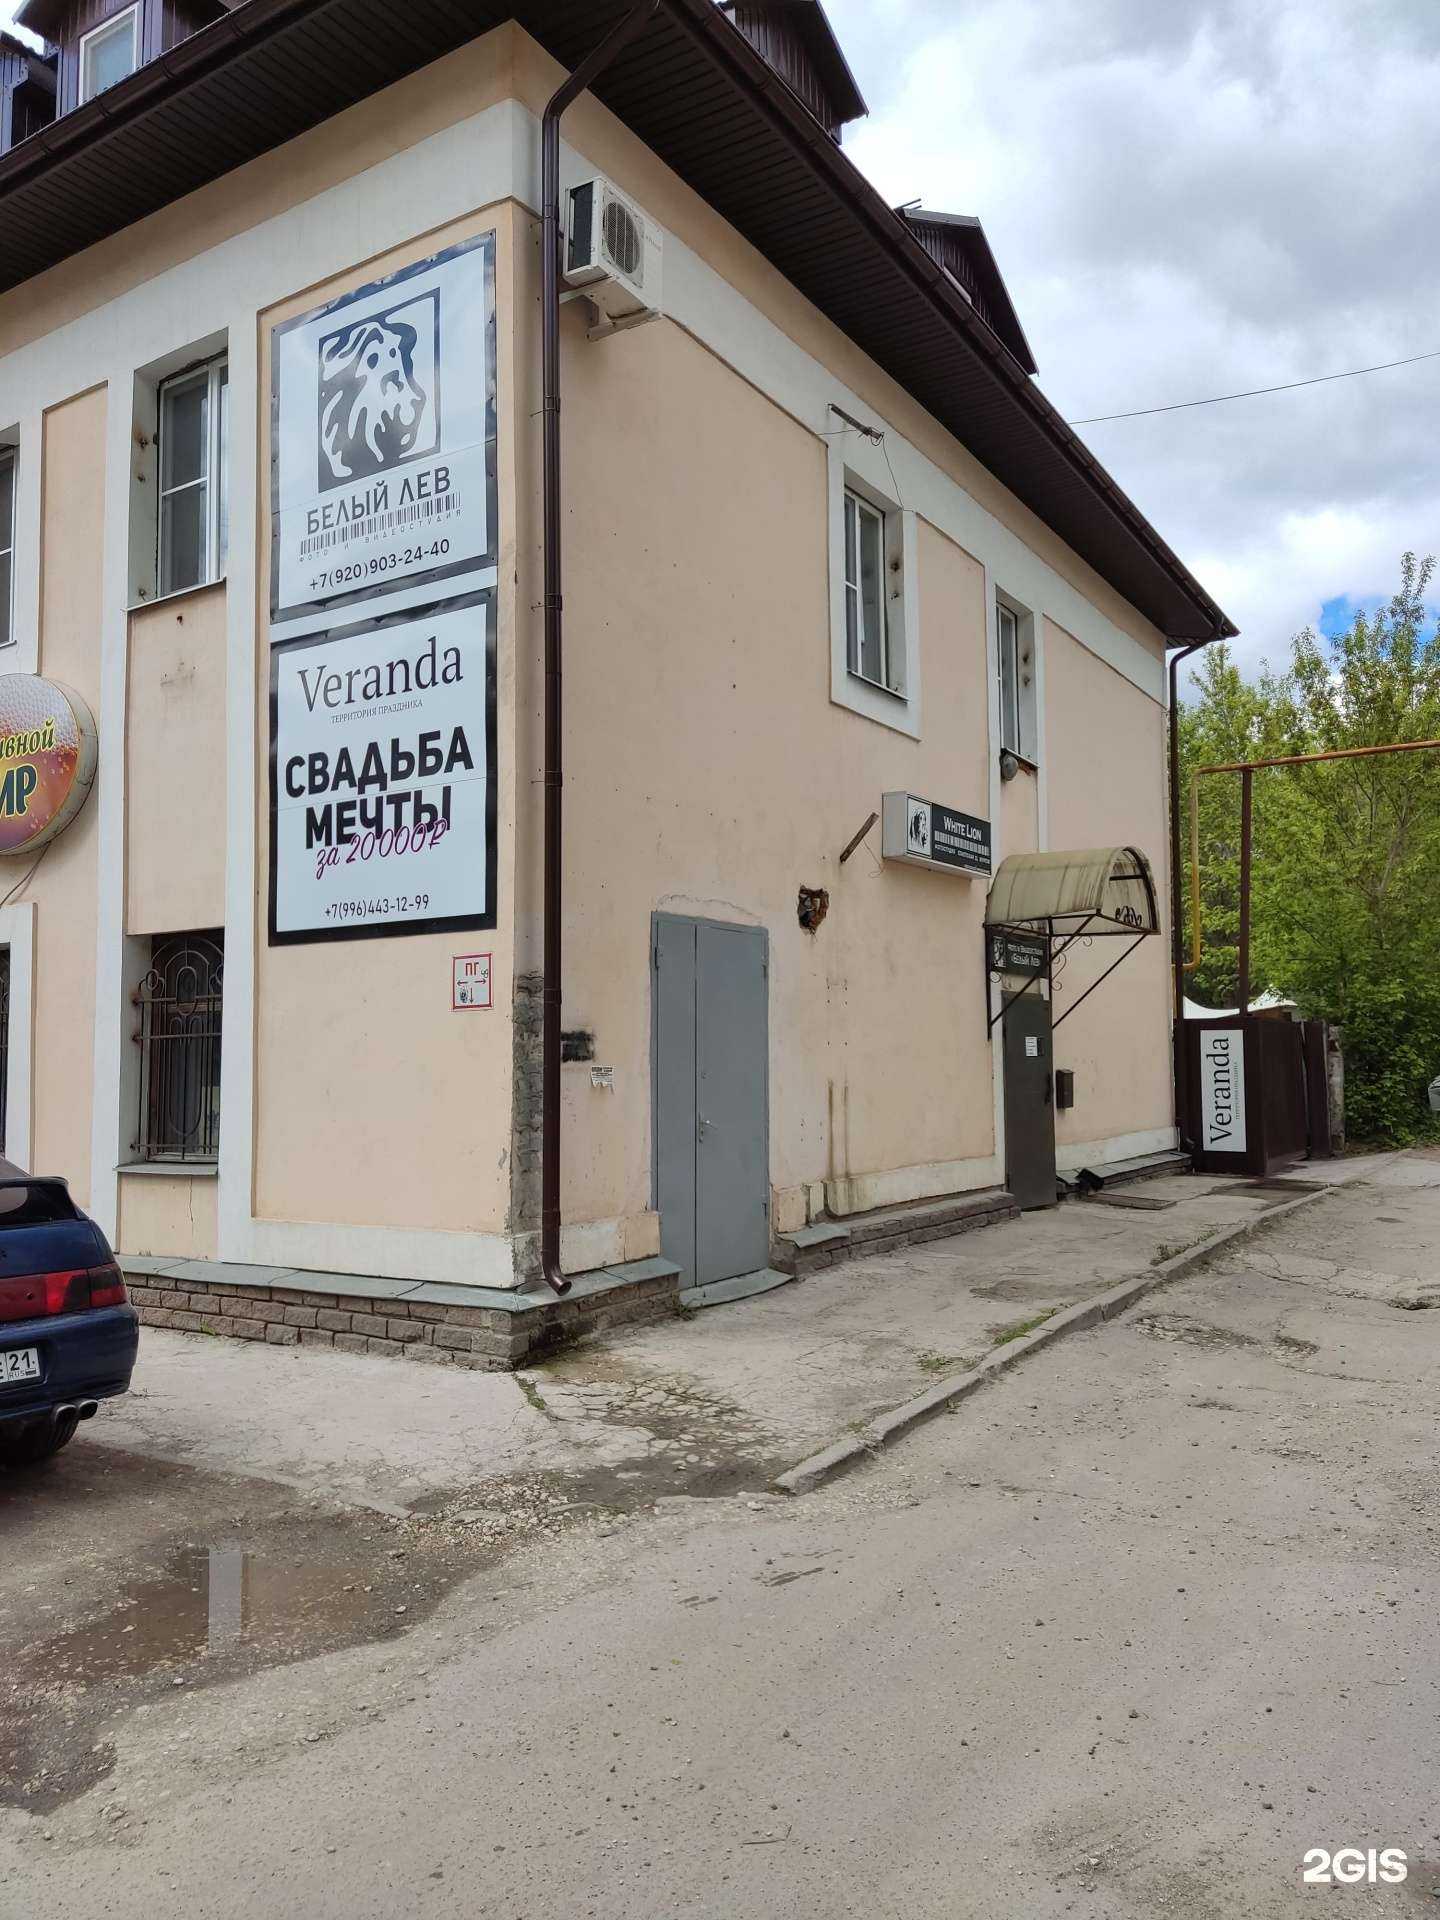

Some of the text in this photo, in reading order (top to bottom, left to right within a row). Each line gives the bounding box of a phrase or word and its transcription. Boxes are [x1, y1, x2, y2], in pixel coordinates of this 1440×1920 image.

[306, 466, 451, 535] БЕЛЫЙ ЛЕВ
[309, 539, 450, 590] +7(920)903-24-40
[297, 636, 463, 712] Veranda
[331, 699, 423, 724] ТЕРРИТОРИЯ ПРАЗДНИКА
[286, 726, 474, 798] СВАДЬБА
[306, 785, 451, 849] МЕЧТЫ
[316, 847, 340, 880] за
[325, 894, 429, 920] +7(996)443-12-99
[466, 962, 479, 976] ПГ
[1206, 1037, 1232, 1144] Veranda
[9, 1351, 31, 1371] 21
[9, 1369, 25, 1378] RUS
